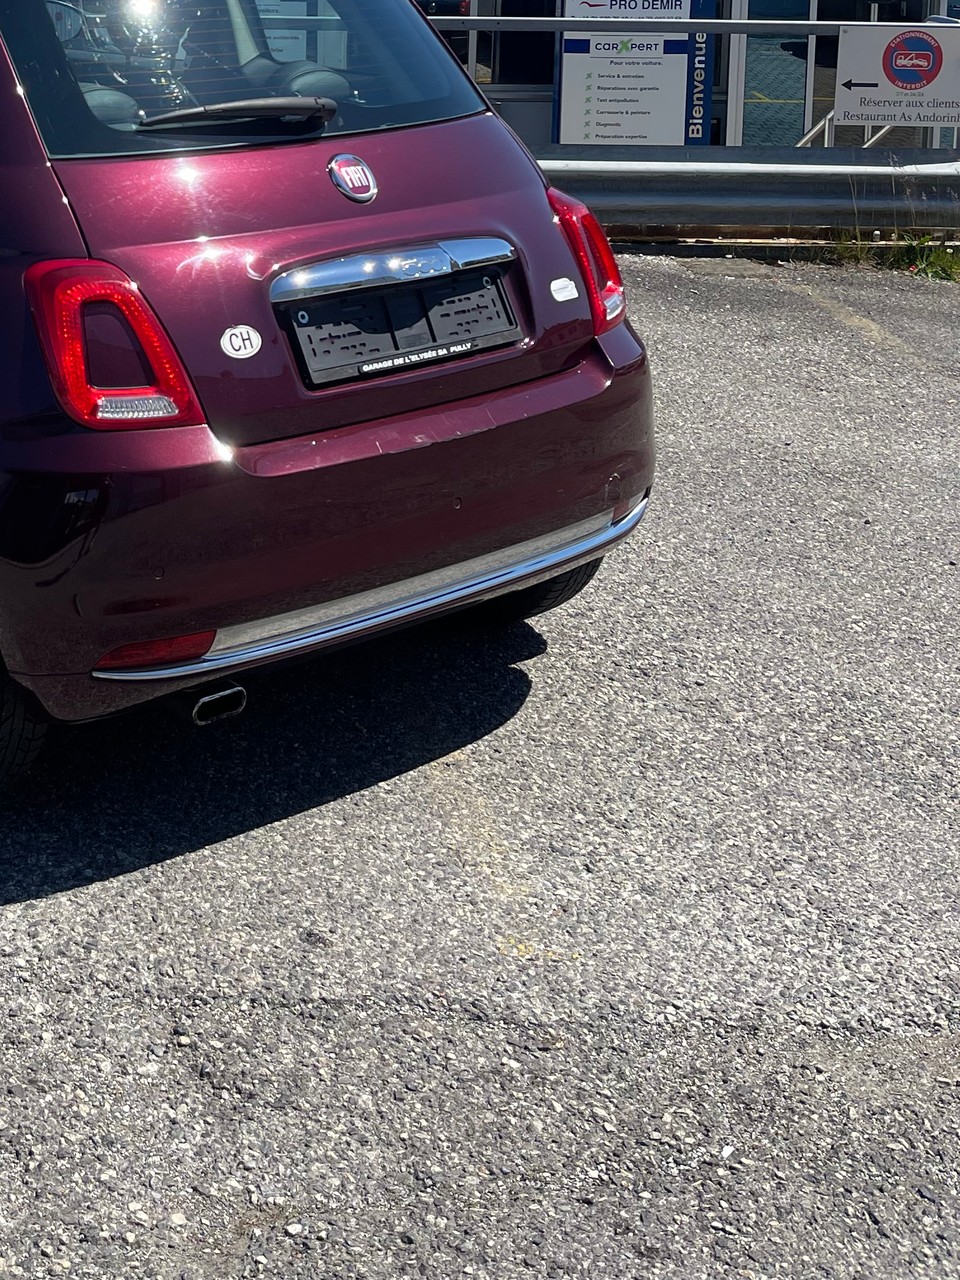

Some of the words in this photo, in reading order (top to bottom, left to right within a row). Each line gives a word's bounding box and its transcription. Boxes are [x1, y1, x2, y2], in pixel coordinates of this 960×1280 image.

[609, 0, 638, 10] PRO
[642, 0, 683, 10] DEMIR
[890, 31, 938, 48] STATIONNEMENT
[688, 32, 707, 138] Bienvenue
[895, 79, 928, 90] INTERDIT
[859, 96, 904, 108] Réserver
[905, 100, 924, 108] aux
[927, 98, 960, 109] clients
[843, 111, 897, 122] Restaurant
[900, 112, 912, 122] As
[341, 165, 369, 189] FIAT
[229, 330, 254, 352] CH
[362, 359, 393, 372] GARAGE
[393, 356, 405, 366] DE
[437, 347, 448, 356] SA
[449, 342, 472, 353] PULLY
